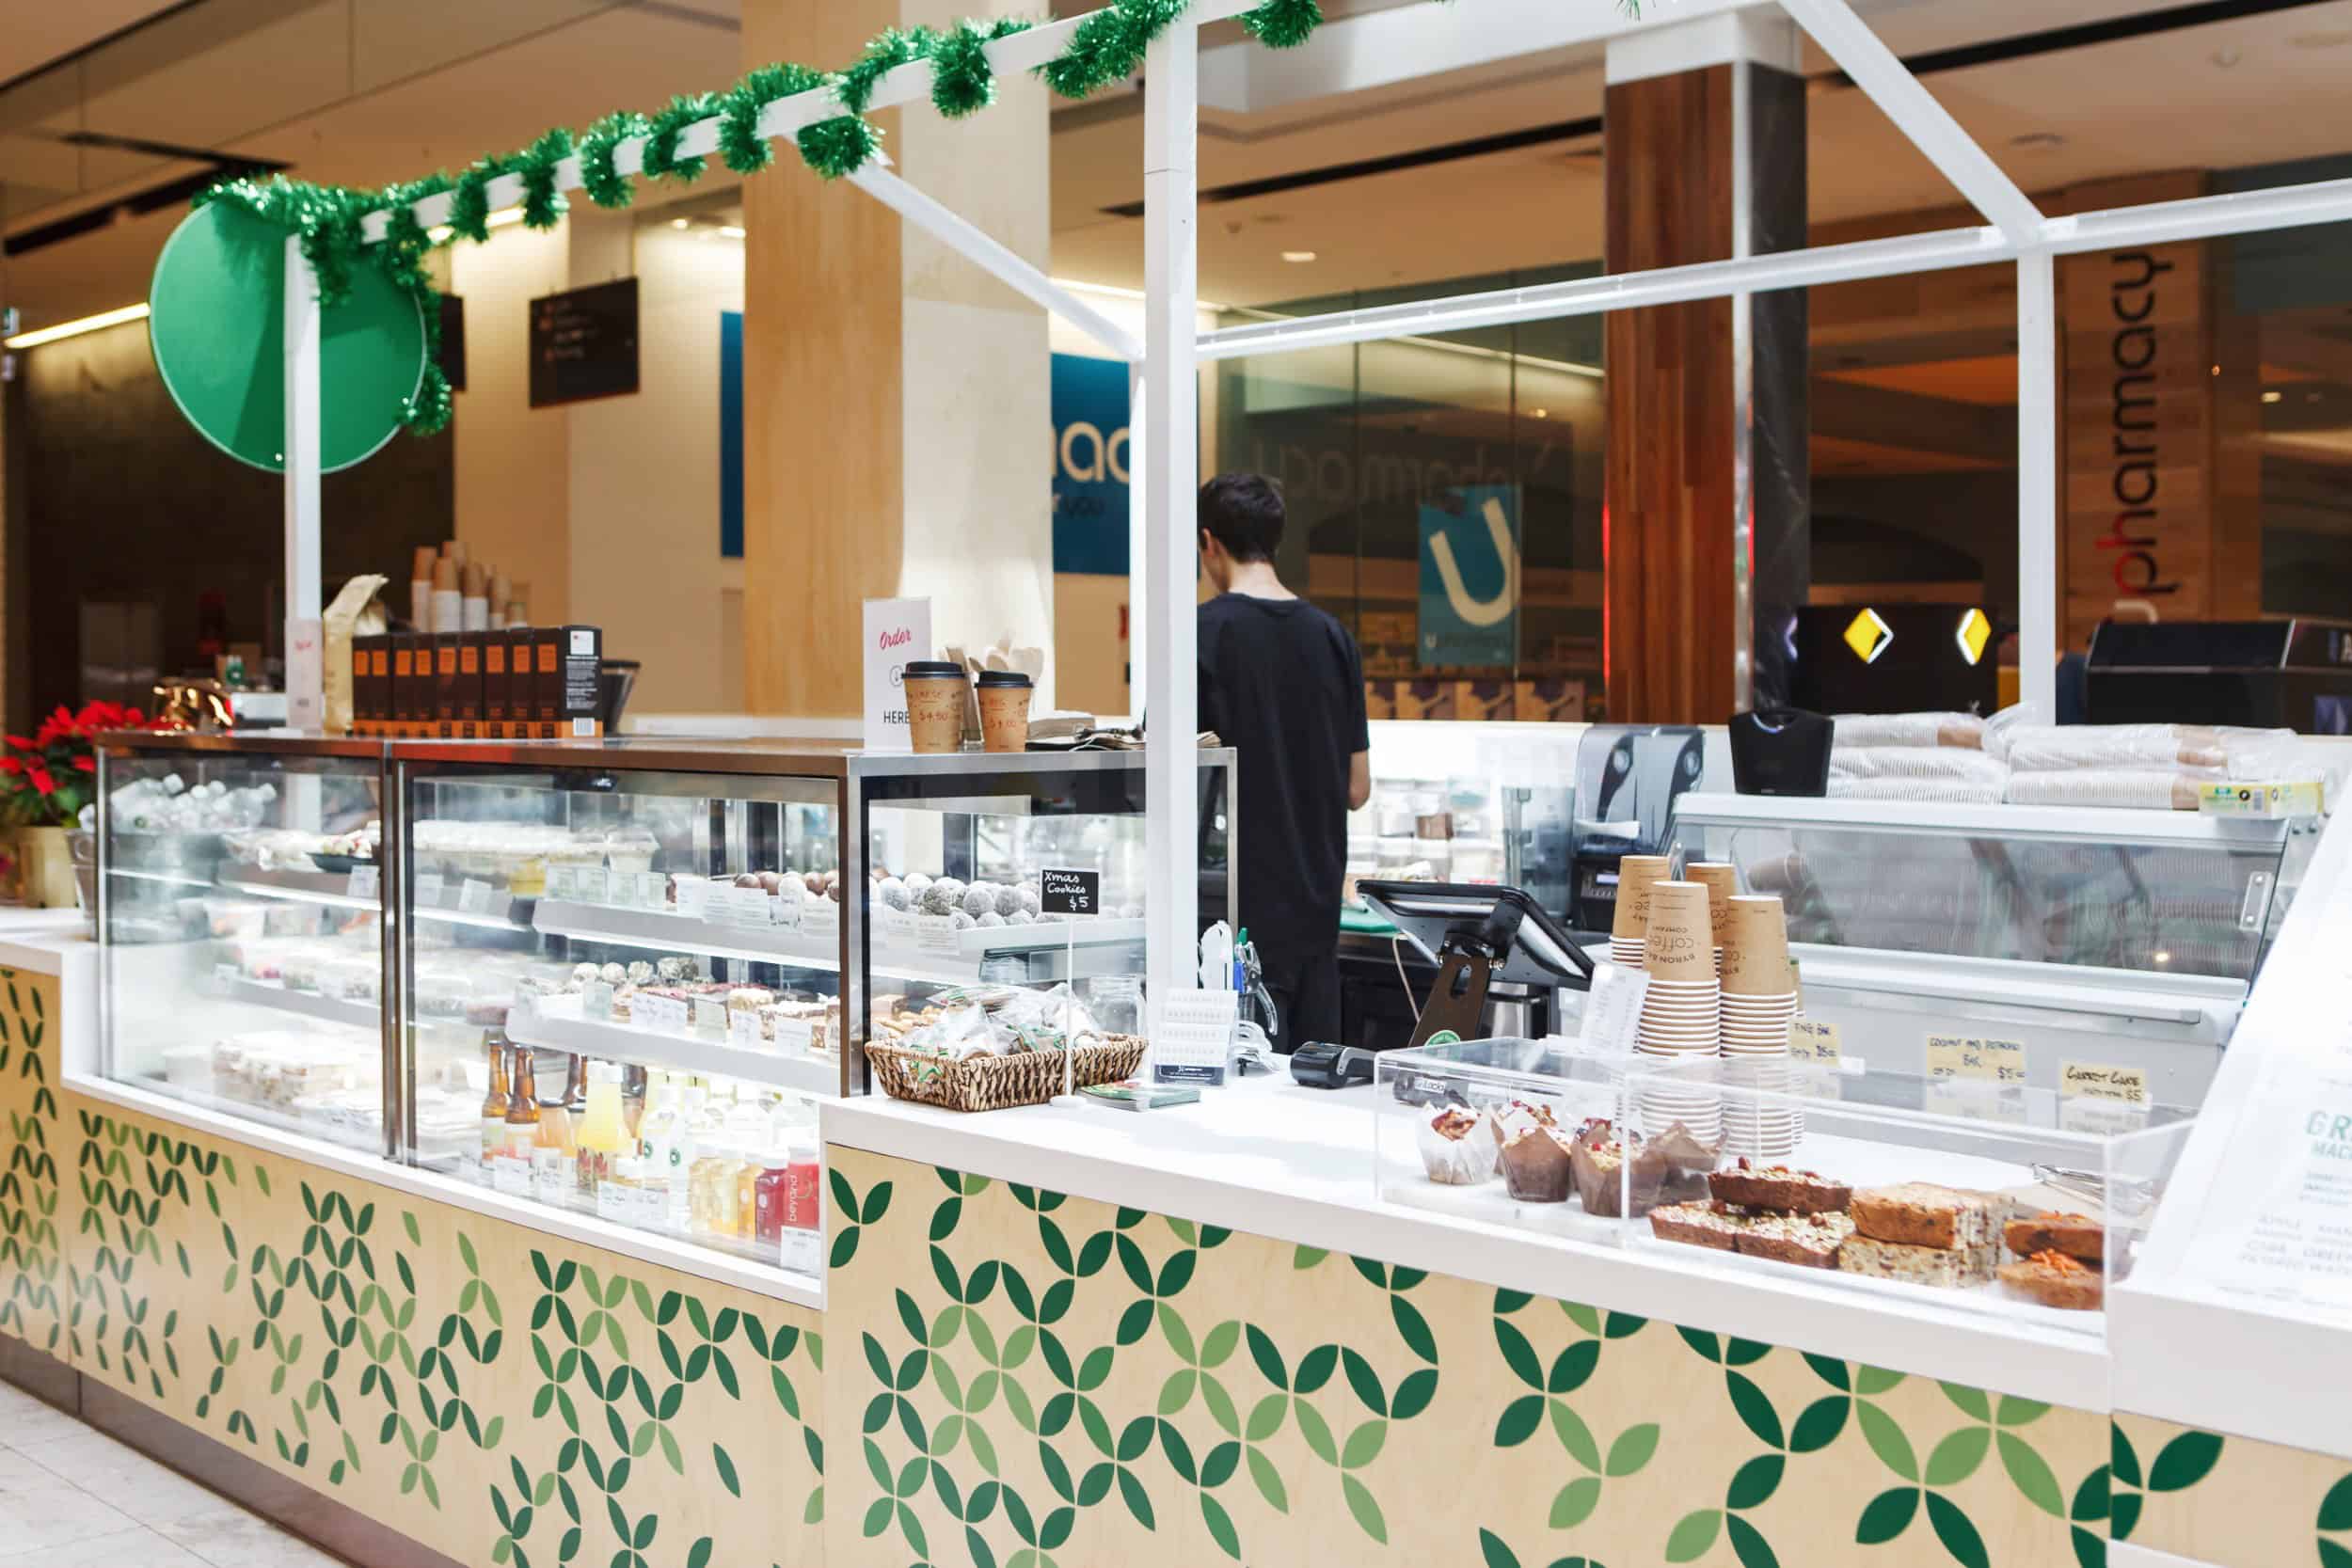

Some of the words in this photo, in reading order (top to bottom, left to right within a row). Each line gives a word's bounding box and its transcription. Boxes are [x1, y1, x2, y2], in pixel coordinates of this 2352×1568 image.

[880, 627, 912, 650] Order
[883, 709, 911, 724] HERE
[1044, 871, 1080, 883] Xmas
[1047, 882, 1086, 894] Cookies
